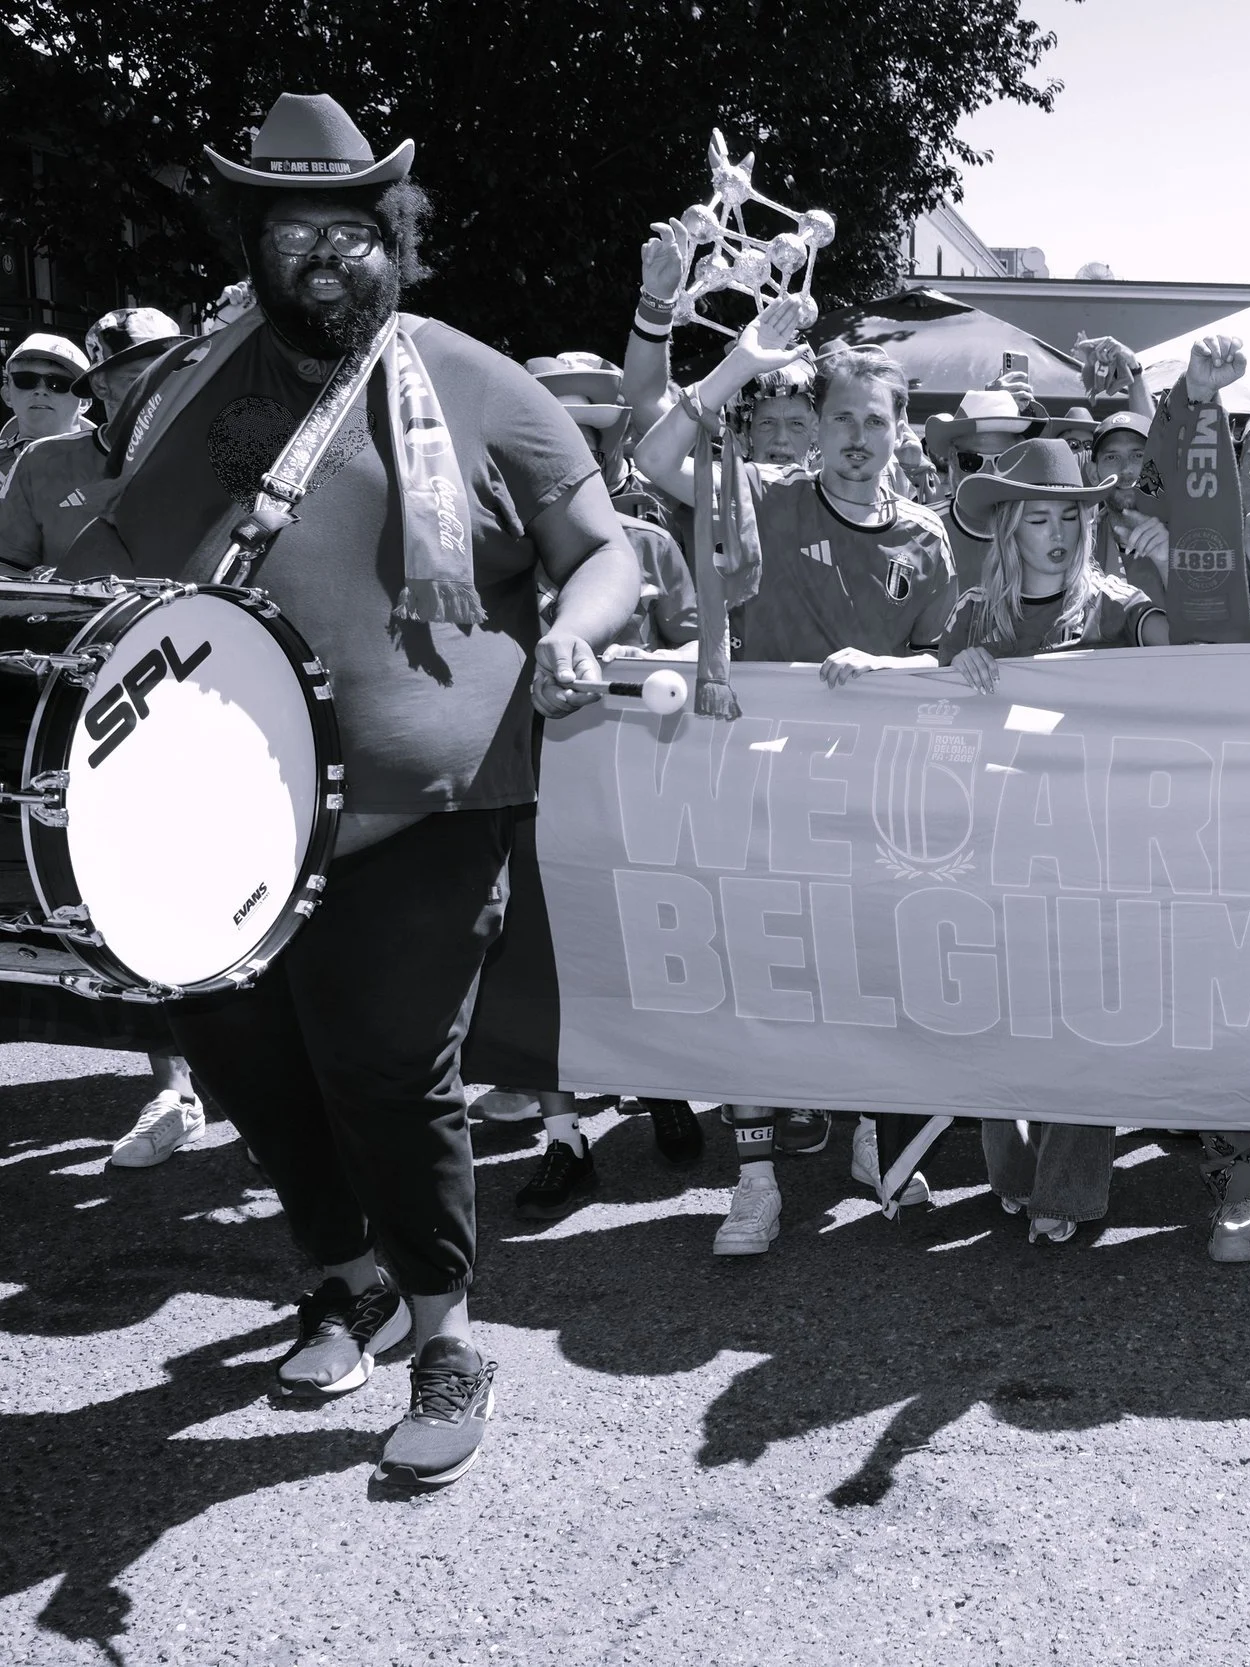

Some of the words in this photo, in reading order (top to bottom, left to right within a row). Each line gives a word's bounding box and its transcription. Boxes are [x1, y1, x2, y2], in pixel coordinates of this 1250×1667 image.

[270, 161, 283, 171] WE
[291, 162, 309, 172] ARE
[311, 162, 351, 173] BELGIUM
[1177, 551, 1227, 570] 1895
[84, 636, 212, 769] SPL
[935, 735, 966, 745] ROYAL
[615, 708, 860, 876] WE
[233, 881, 268, 926] EVANS
